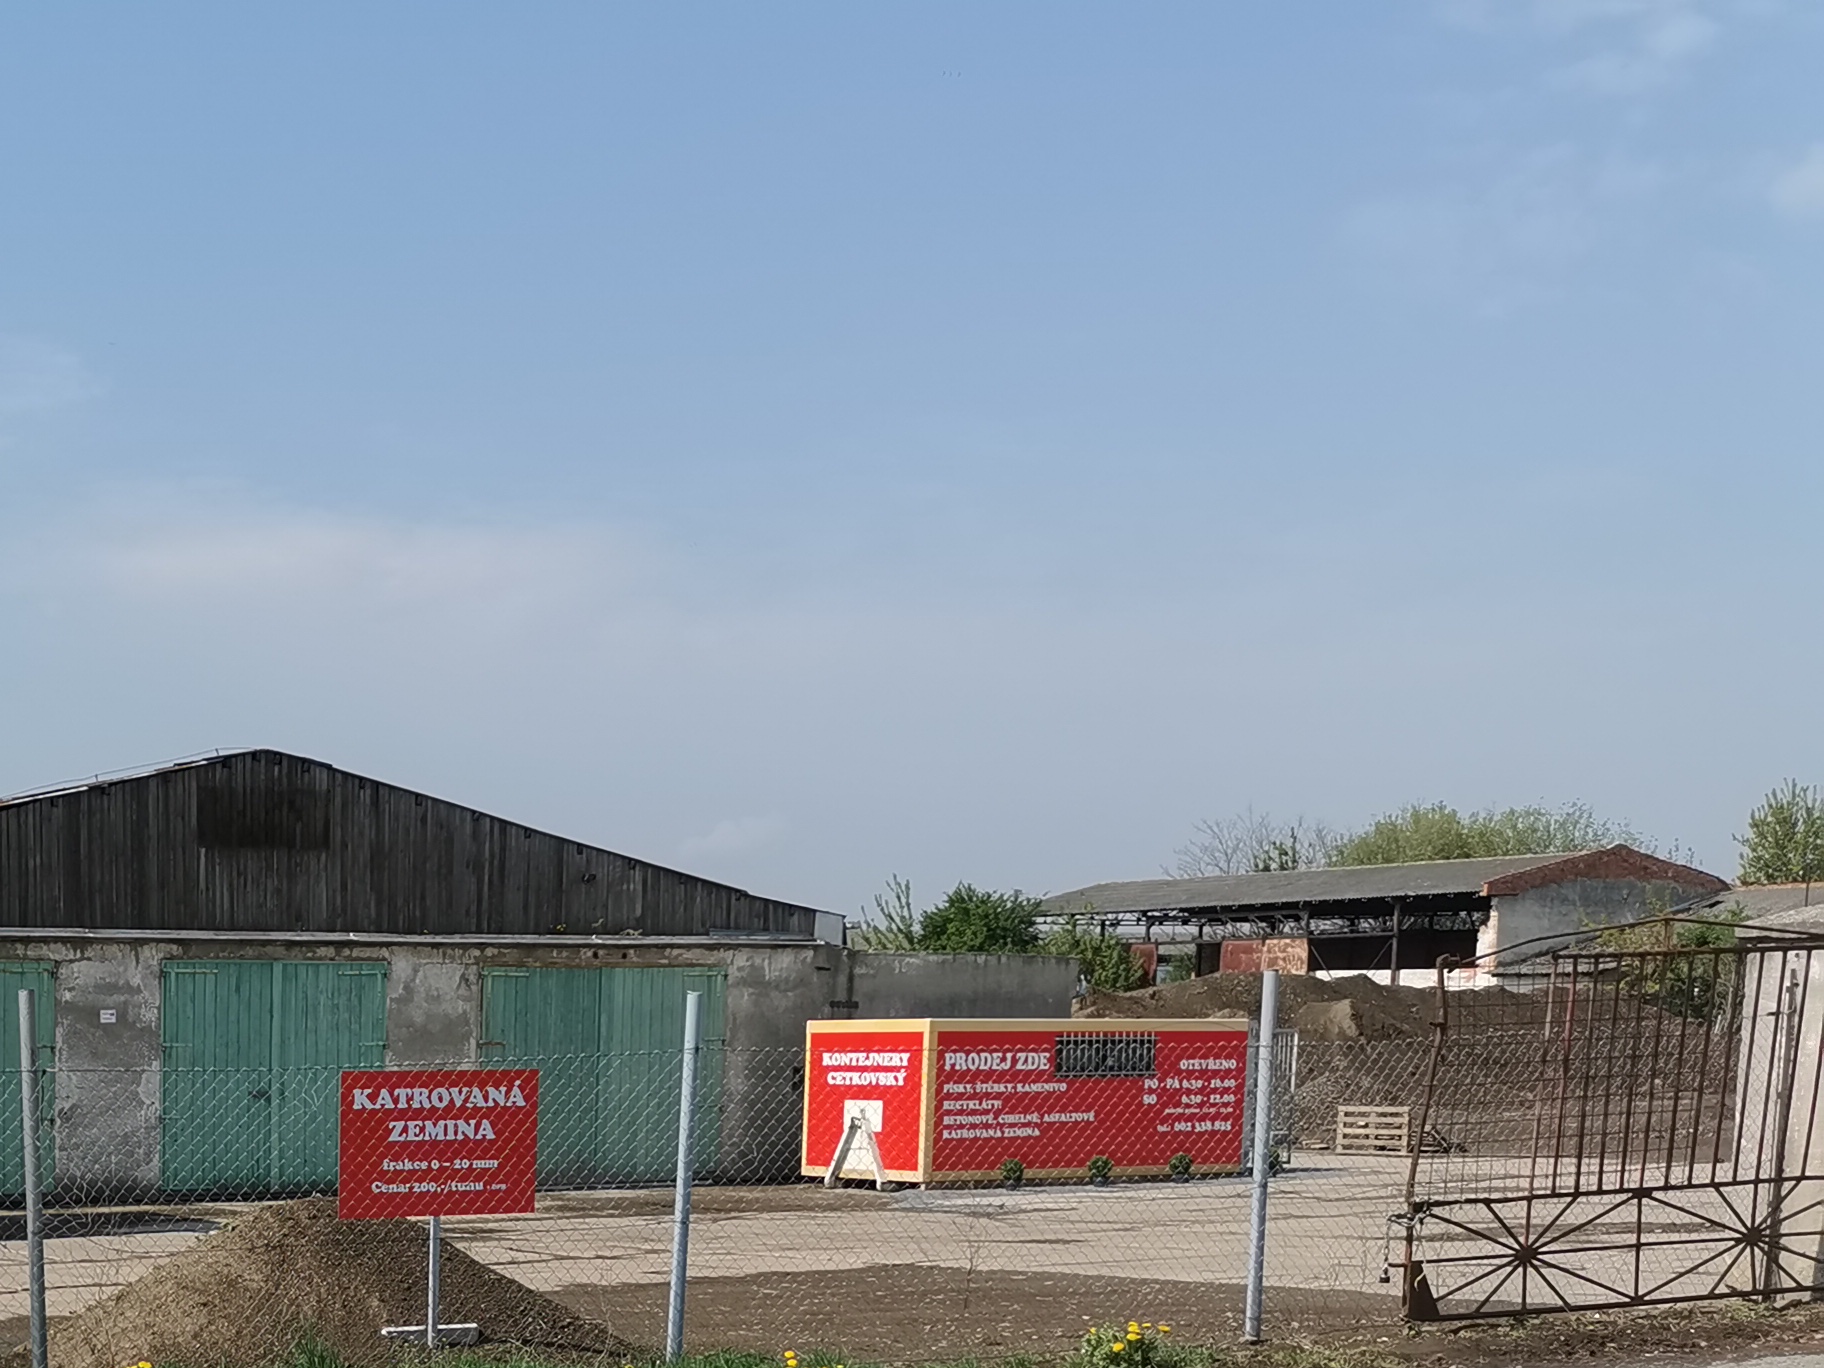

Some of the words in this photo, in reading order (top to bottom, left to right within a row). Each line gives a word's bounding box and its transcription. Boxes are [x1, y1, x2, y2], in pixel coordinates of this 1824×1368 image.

[822, 1052, 910, 1067] KONTEJNERY
[944, 1052, 1012, 1071] PRODEJ
[1016, 1052, 1051, 1070] ZDE
[1179, 1057, 1237, 1070] OTEVŘENO
[826, 1068, 907, 1086] CETKOVSKÝ
[1143, 1079, 1159, 1089] PO
[1166, 1076, 1180, 1089] PÁ
[1016, 1082, 1068, 1092] KAMENIVO
[353, 1080, 526, 1110] KATROVANÁ
[1142, 1094, 1157, 1104] SO
[388, 1118, 497, 1142] ZEMINA
[383, 1158, 428, 1171] frakce
[431, 1160, 440, 1170] 0
[453, 1159, 470, 1169] 20
[472, 1160, 499, 1168] mm
